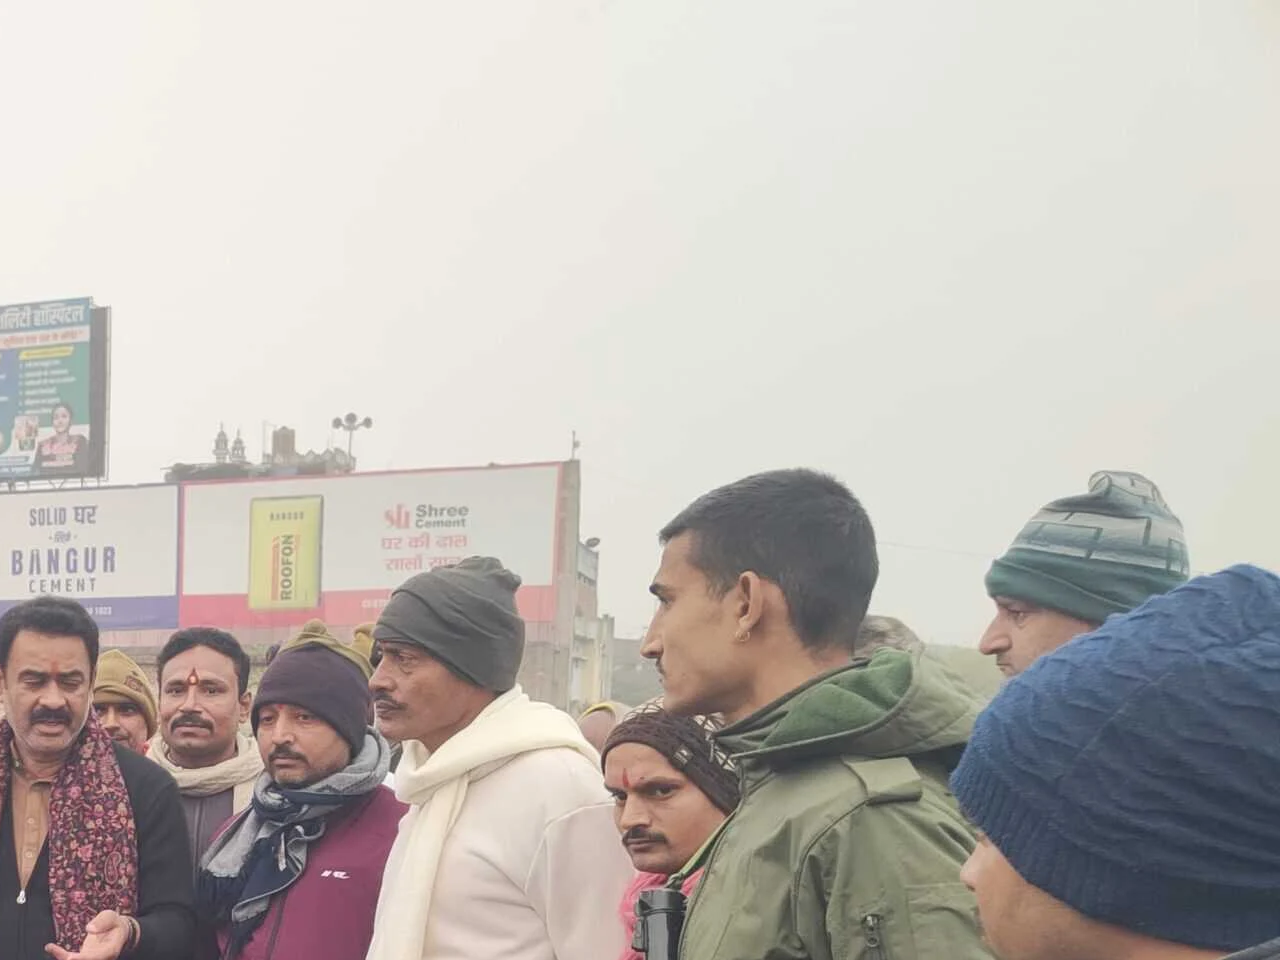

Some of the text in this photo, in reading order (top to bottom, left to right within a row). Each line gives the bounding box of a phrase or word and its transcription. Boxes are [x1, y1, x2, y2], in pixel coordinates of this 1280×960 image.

[29, 505, 98, 526] SOLID घर
[415, 504, 469, 518] Shree
[415, 519, 466, 529] Cement
[382, 537, 401, 549] घर
[407, 531, 430, 549] की
[11, 546, 116, 576] BANGUR
[281, 534, 294, 601] ROOFON
[28, 578, 96, 593] CEMENT
